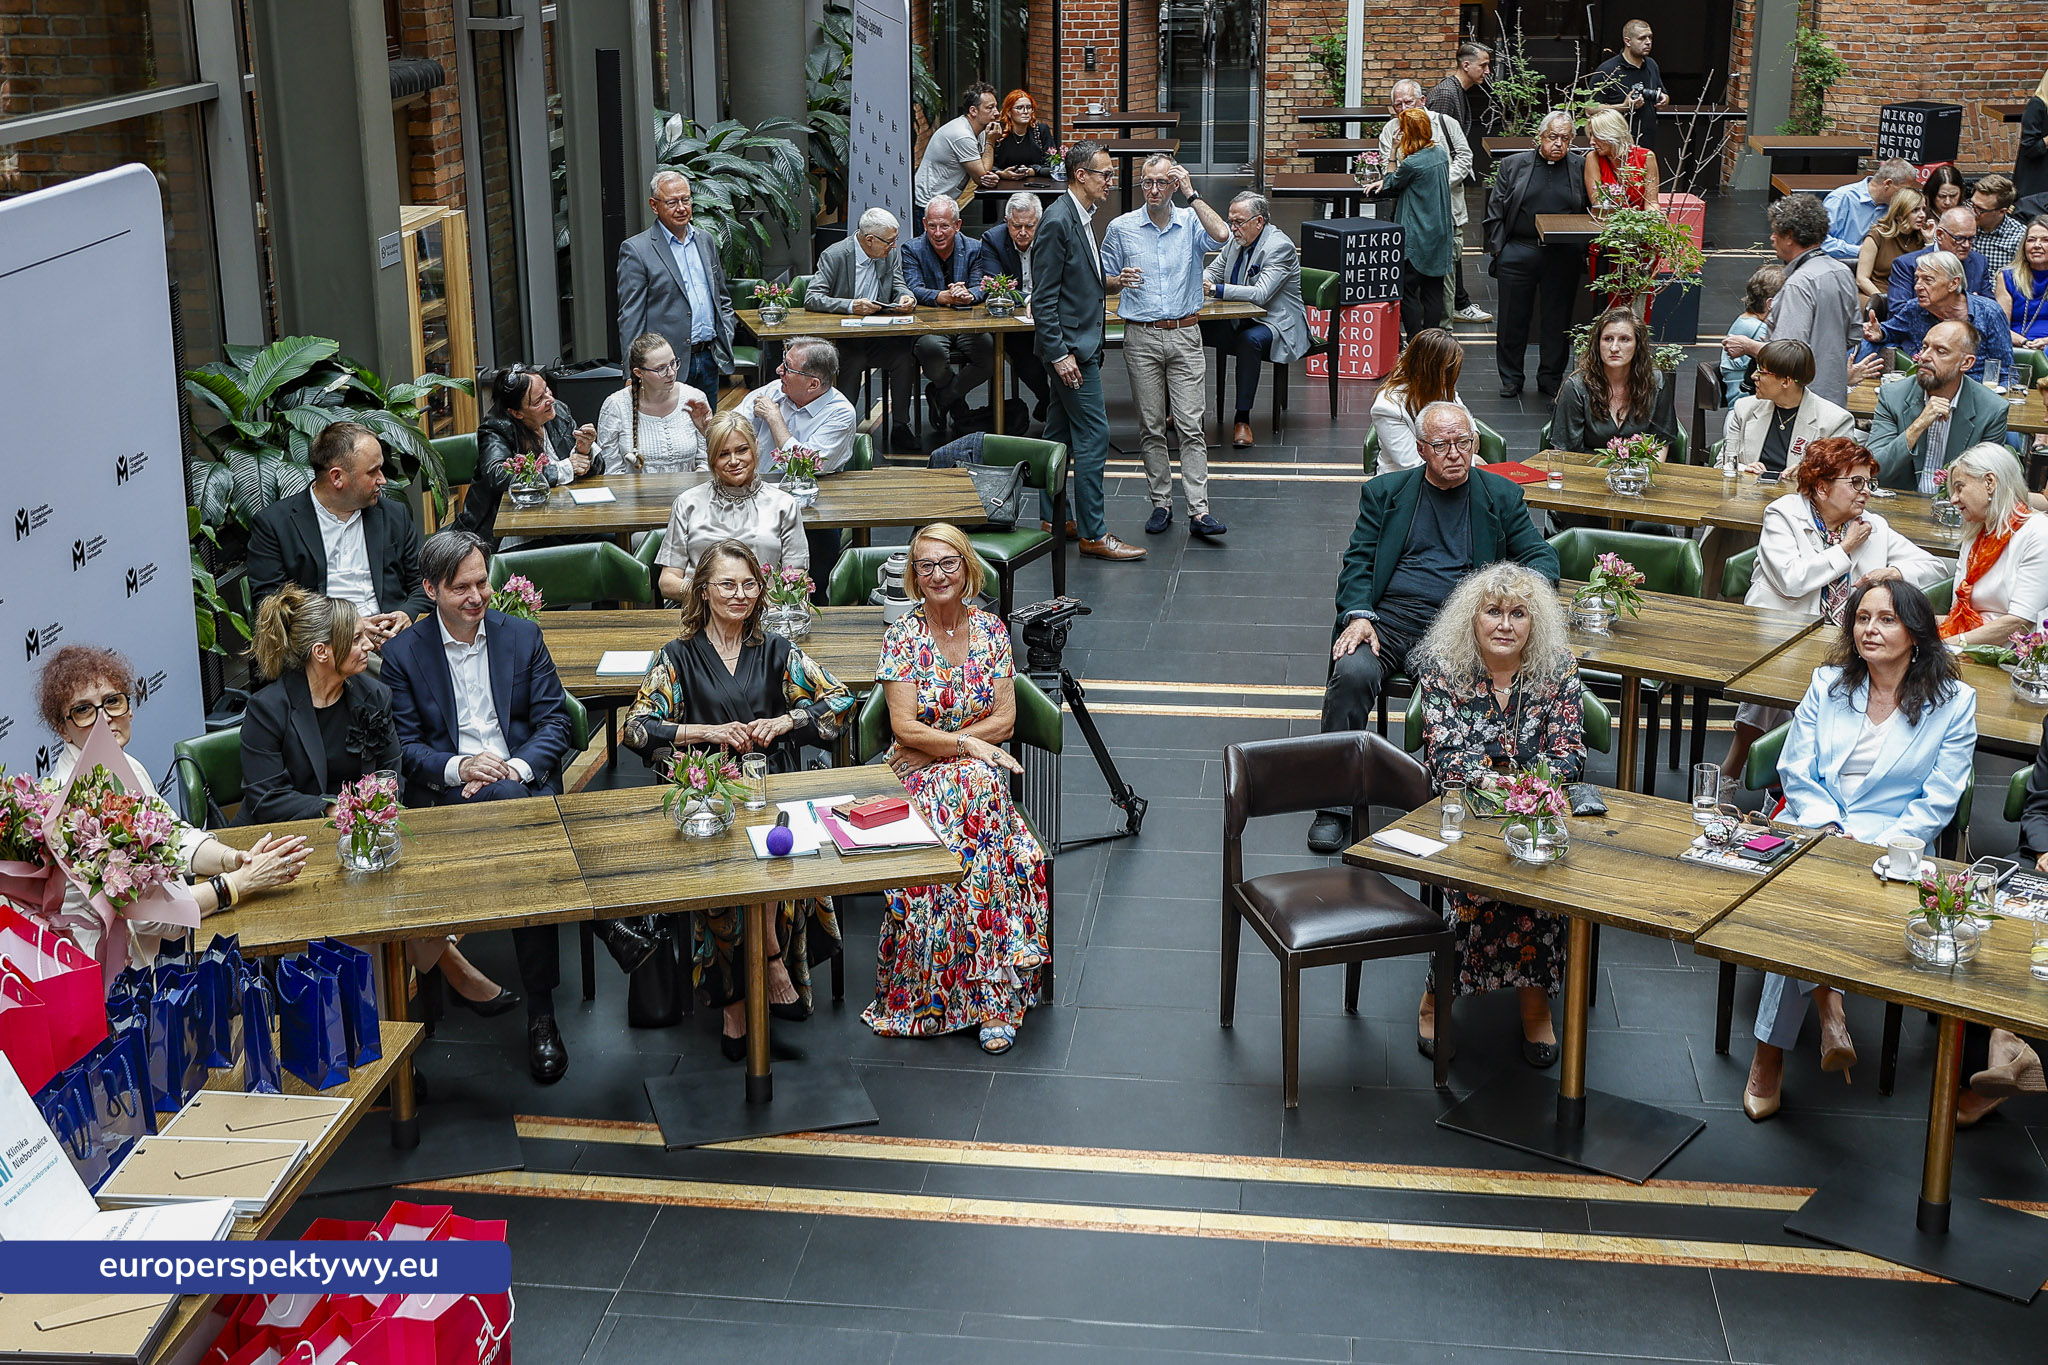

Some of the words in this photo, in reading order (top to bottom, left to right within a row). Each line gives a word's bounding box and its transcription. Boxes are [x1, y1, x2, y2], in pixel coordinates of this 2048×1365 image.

[1882, 108, 1924, 124] MIKRO
[1881, 121, 1922, 136] MAKRO
[1880, 134, 1921, 149] METRO
[1346, 231, 1401, 248] MIKRO
[1345, 249, 1400, 266] MAKRO
[1345, 266, 1400, 283] METRO
[1345, 283, 1399, 300] POLIA
[5, 1138, 30, 1160] Klinika
[12, 1135, 49, 1170] Nieborowice
